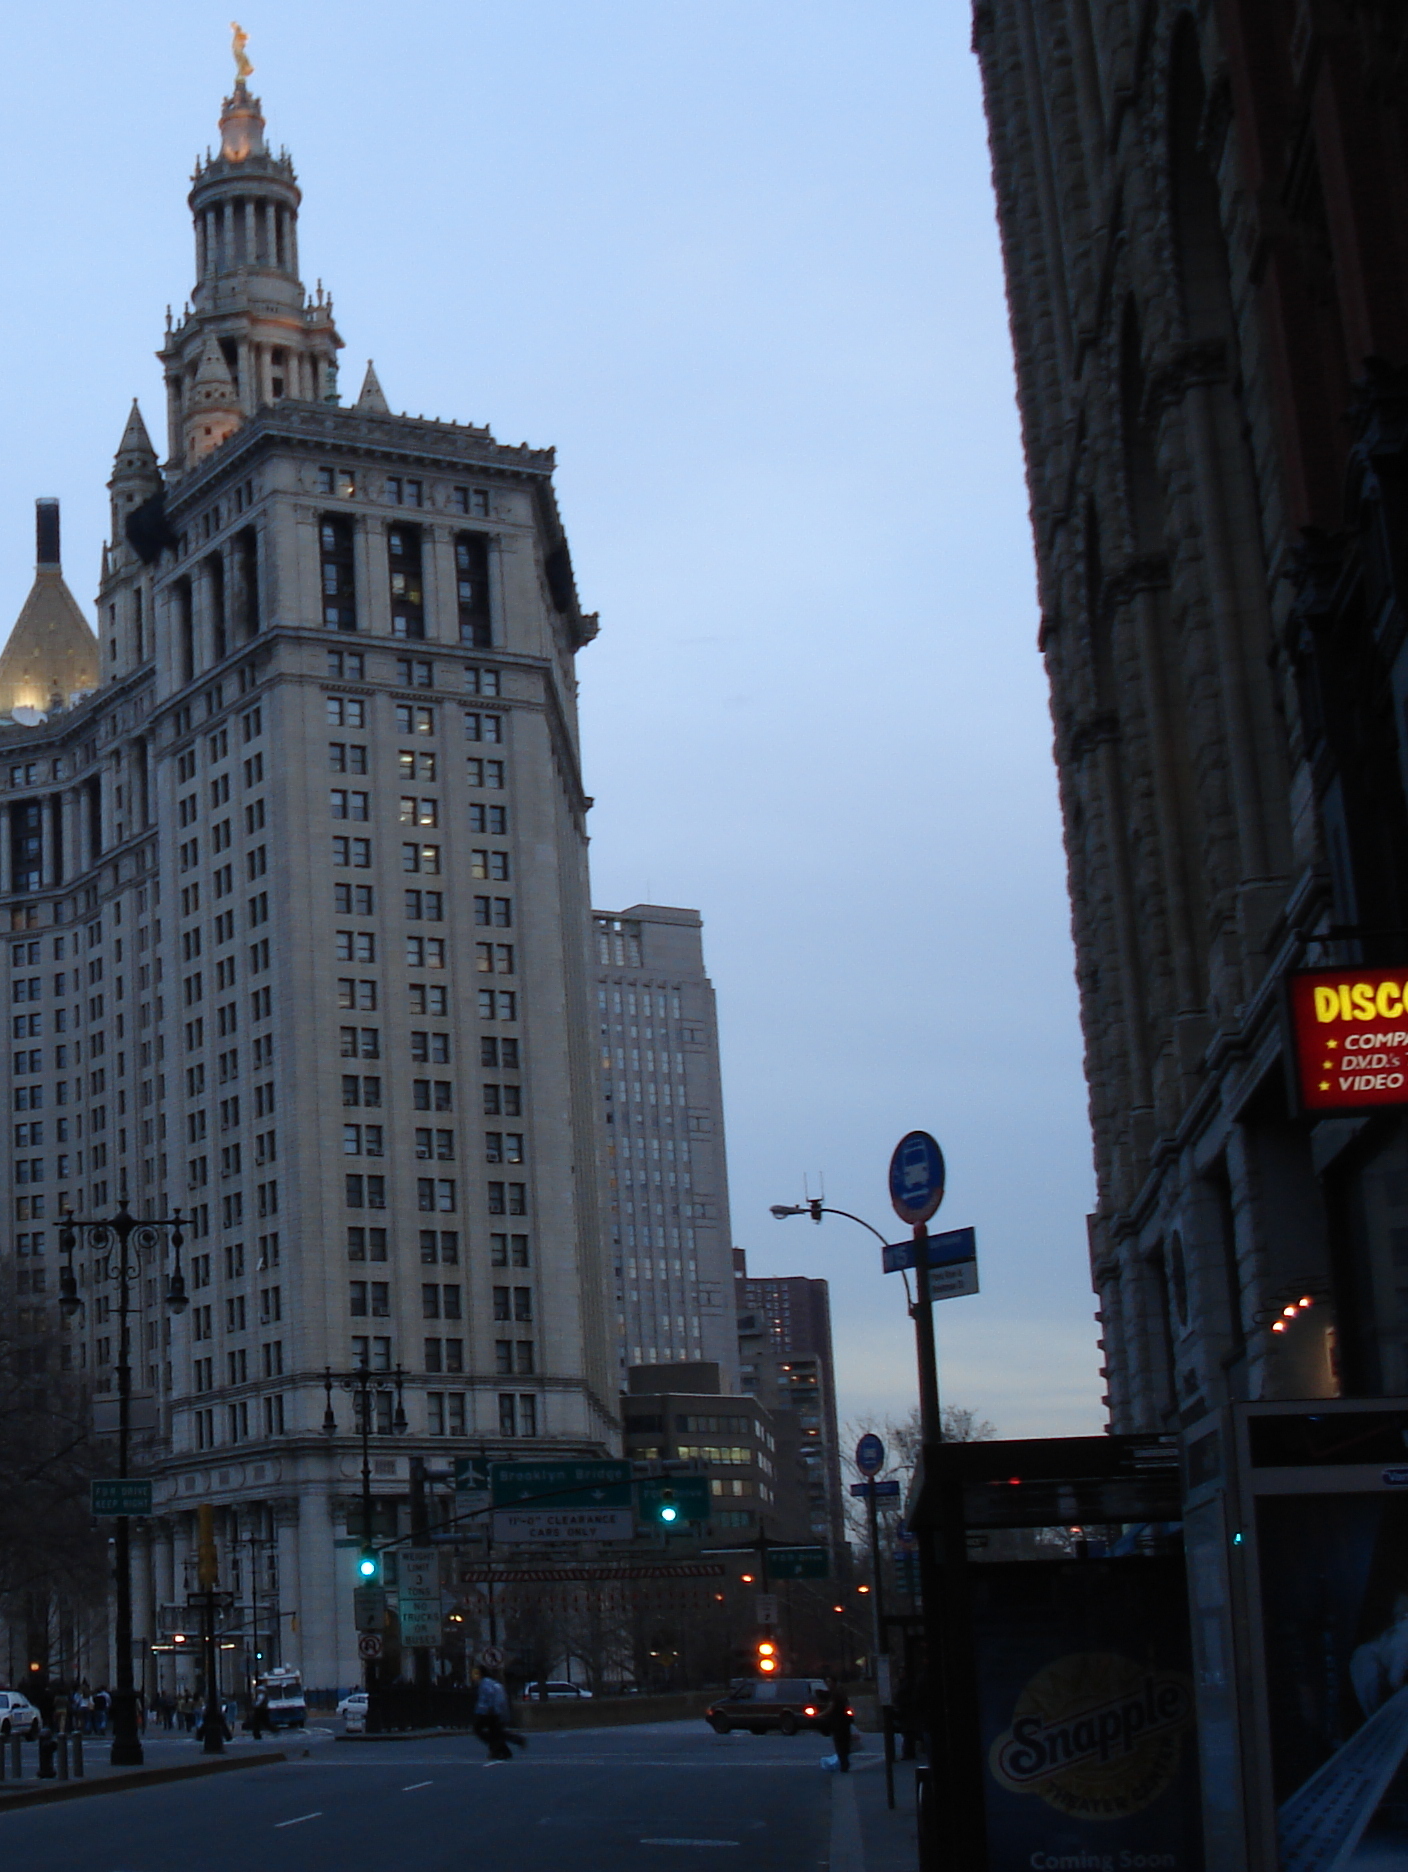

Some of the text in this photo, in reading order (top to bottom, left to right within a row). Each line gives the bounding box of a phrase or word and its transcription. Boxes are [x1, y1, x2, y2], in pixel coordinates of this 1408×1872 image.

[1313, 981, 1408, 1023] DISC
[1338, 1072, 1404, 1091] VIDEO
[499, 1468, 623, 1483] Brooklyn Bridge
[547, 1515, 616, 1525] CLEARANCE
[529, 1527, 597, 1538] CARS ONLY
[407, 1563, 429, 1572] LIMIT
[416, 1574, 423, 1585] 3
[408, 1587, 431, 1596] TONS
[414, 1602, 428, 1611] NO
[403, 1613, 439, 1622] TRUCKS
[1009, 1676, 1179, 1775] Snapple
[1049, 1780, 1129, 1813] THEATER
[1029, 1850, 1176, 1872] Coming Soon
